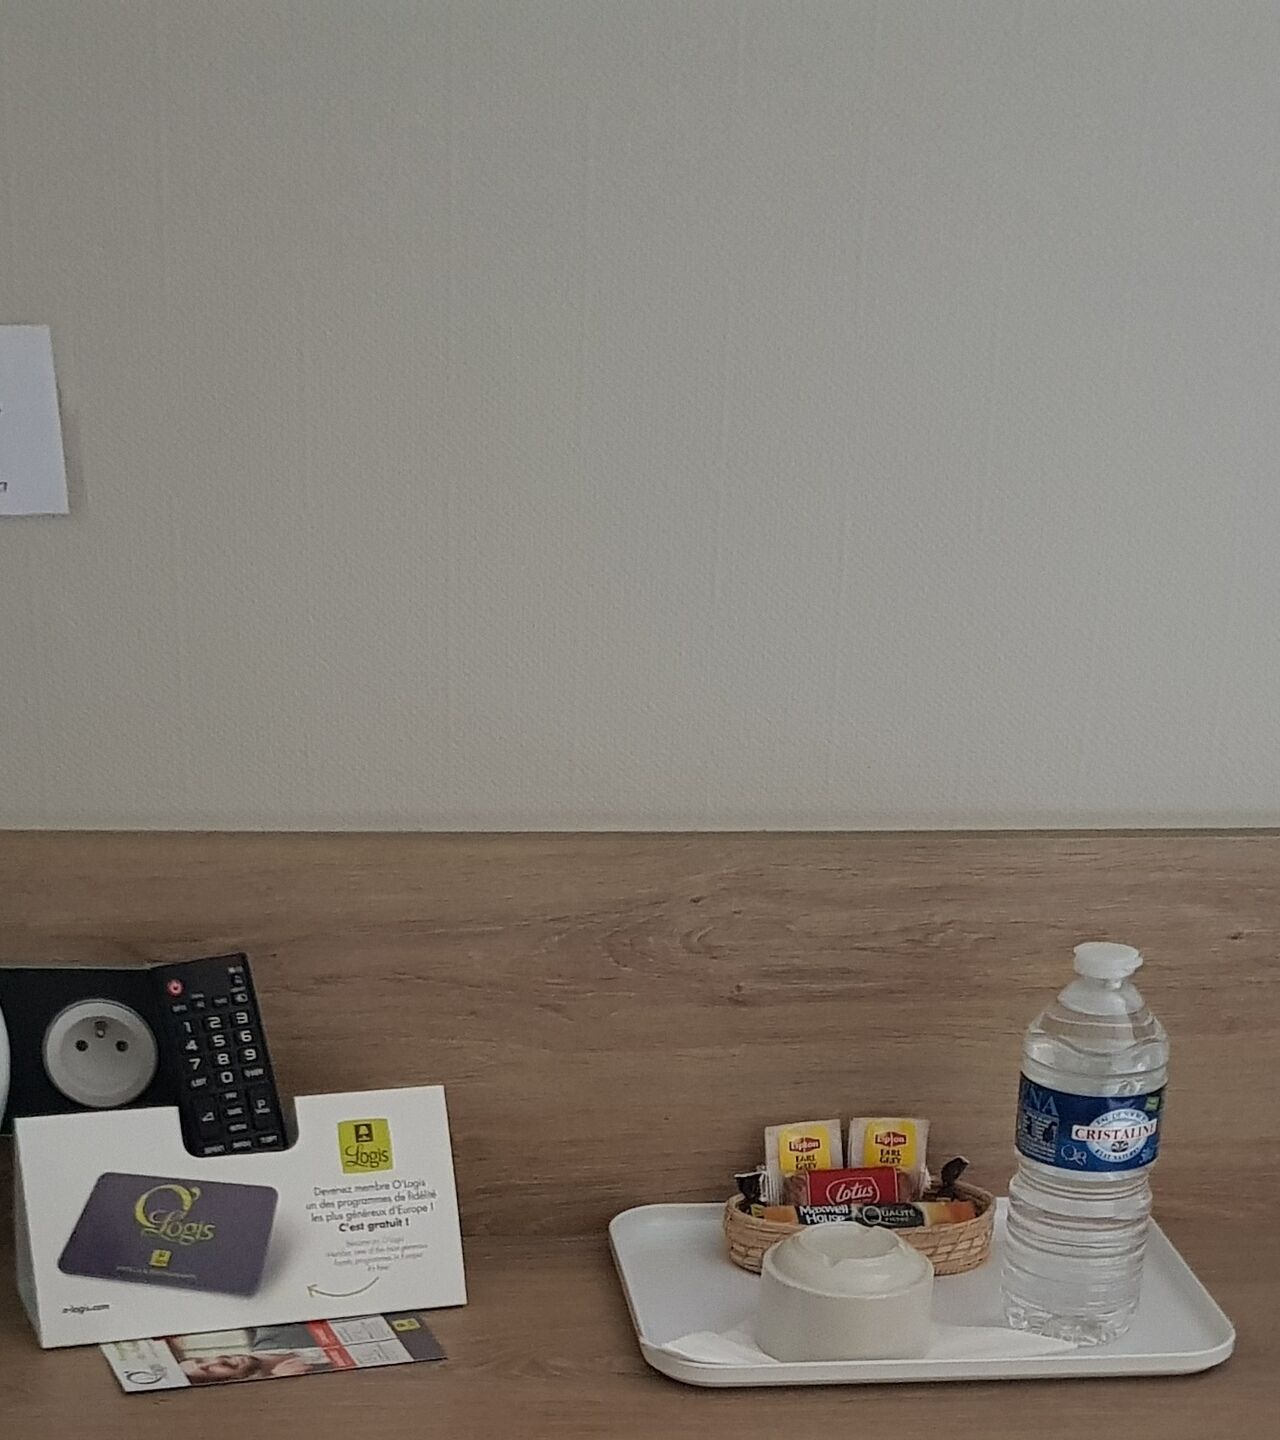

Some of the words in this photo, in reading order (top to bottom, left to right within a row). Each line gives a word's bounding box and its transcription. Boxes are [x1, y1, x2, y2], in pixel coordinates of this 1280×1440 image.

[183, 1021, 193, 1034] 1
[207, 1016, 222, 1029] 2
[235, 1012, 249, 1025] 3
[185, 1039, 198, 1051] 4
[212, 1034, 226, 1047] 5
[239, 1030, 253, 1043] 6
[188, 1057, 202, 1070] 7
[216, 1053, 231, 1066] 8
[244, 1049, 257, 1061] 9
[220, 1071, 234, 1084] 0
[876, 1132, 907, 1145] Lipton
[1074, 1123, 1156, 1141] CRISTALINE
[790, 1139, 820, 1152] Lipton
[880, 1149, 901, 1157] EARL
[344, 1143, 390, 1169] Logis
[795, 1154, 816, 1163] EARL
[313, 1186, 353, 1197] Devenez
[354, 1180, 391, 1192] membre
[835, 1181, 874, 1202] Lotus
[306, 1202, 318, 1210] un
[319, 1199, 335, 1209] des
[337, 1196, 392, 1210] programmes
[394, 1191, 406, 1202] de
[311, 1212, 323, 1223] les
[326, 1211, 344, 1223] plus
[346, 1208, 387, 1222] généreux
[338, 1221, 365, 1232] C'est
[368, 1218, 403, 1232] gratuit
